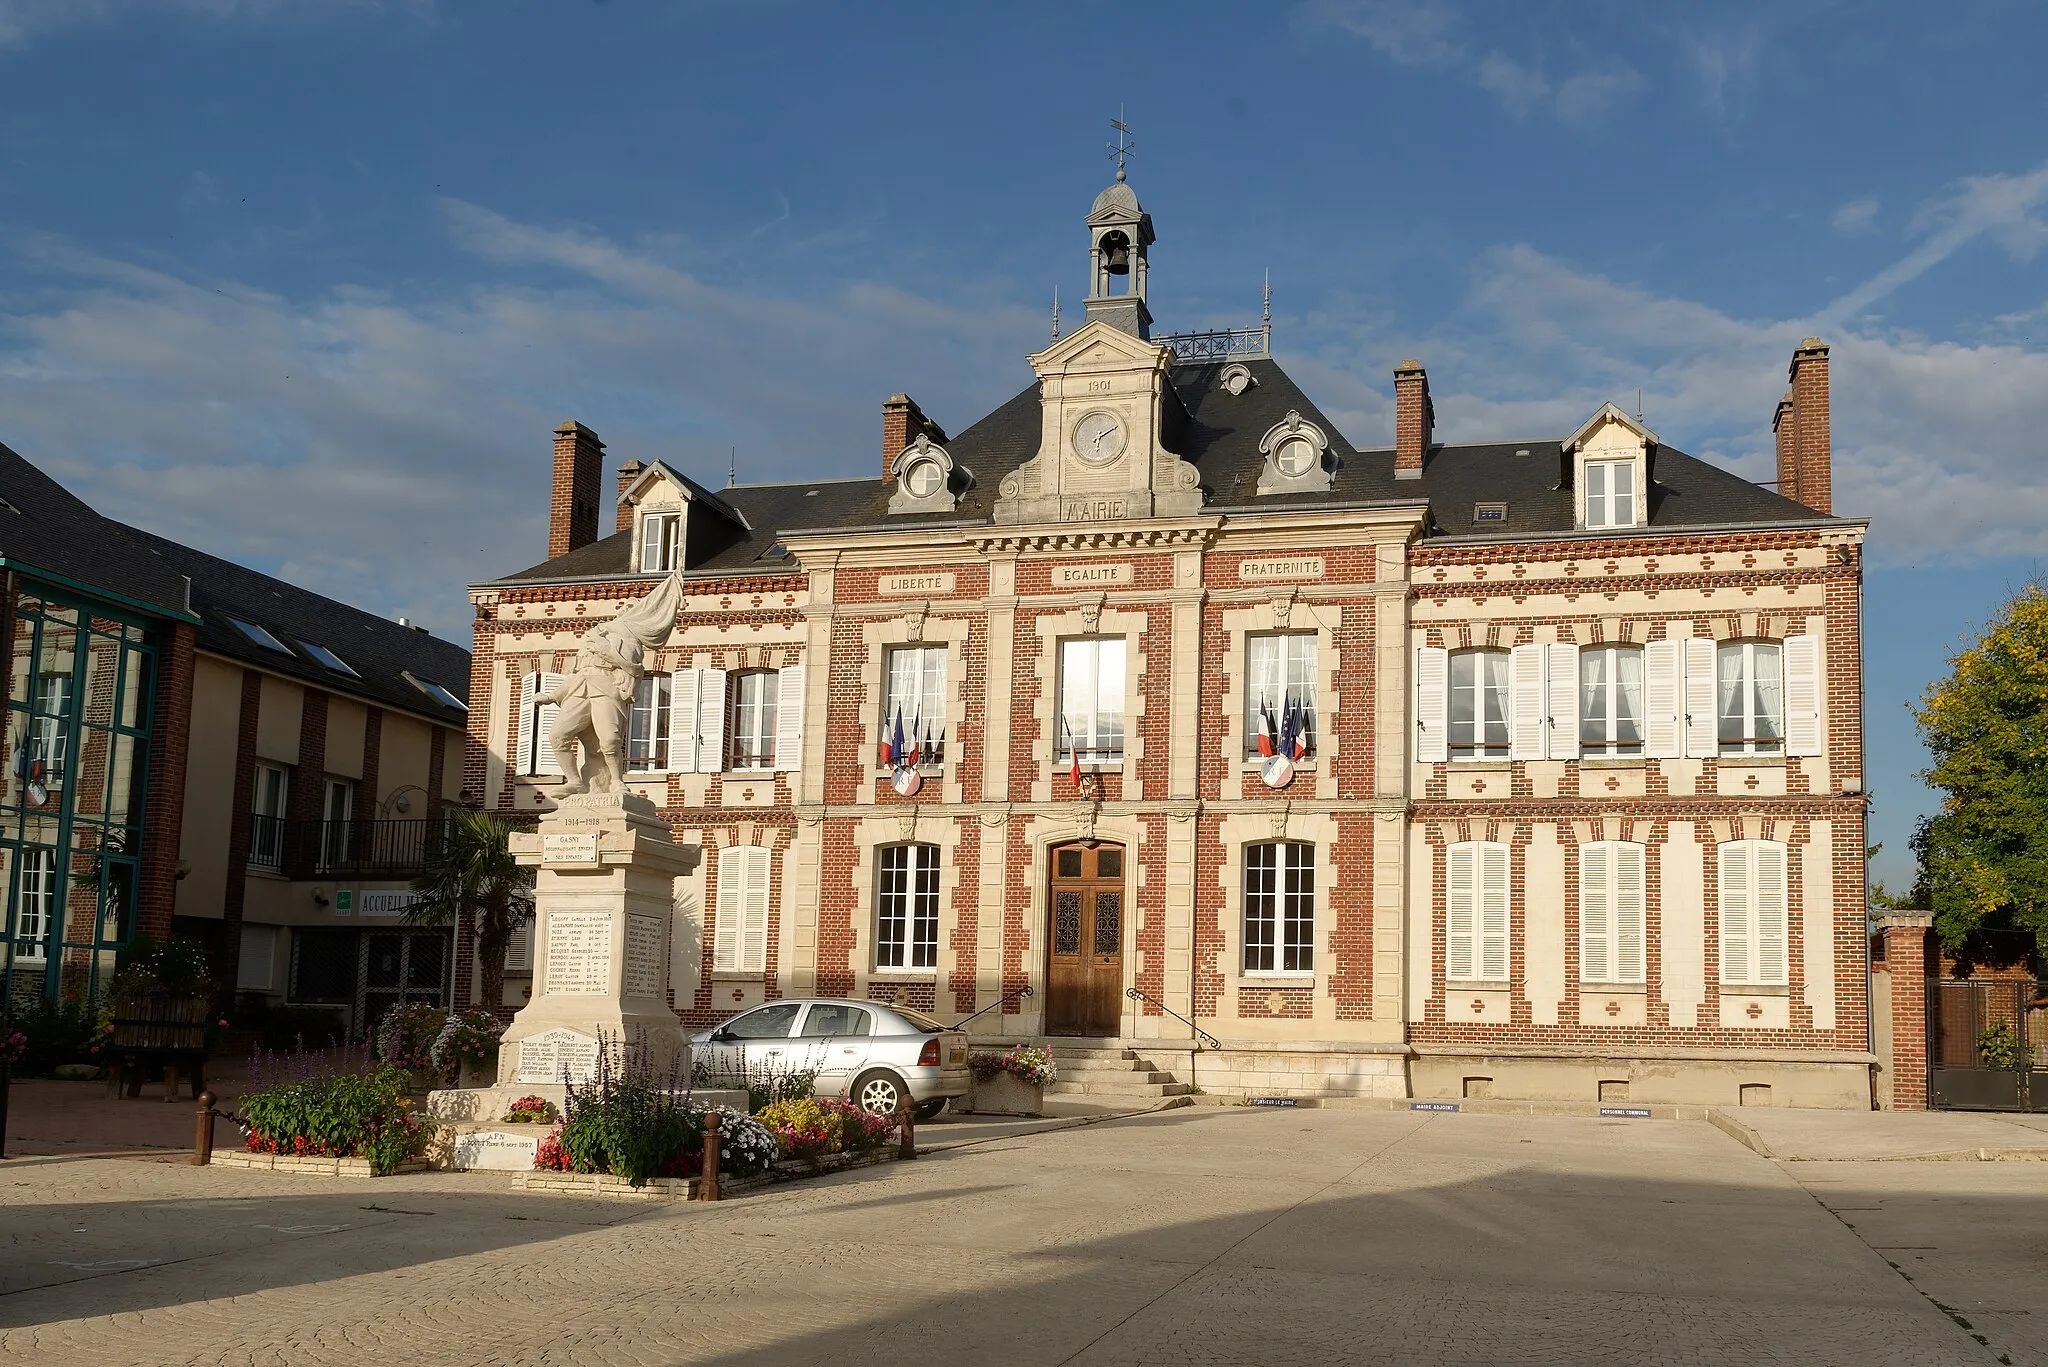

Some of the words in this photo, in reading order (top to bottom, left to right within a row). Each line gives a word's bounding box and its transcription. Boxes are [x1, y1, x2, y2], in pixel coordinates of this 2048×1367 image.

[1067, 501, 1124, 520] MAIRIE
[564, 797, 583, 807] PRO
[585, 795, 620, 807] PATRIA
[362, 895, 404, 913] ACCUEIL
